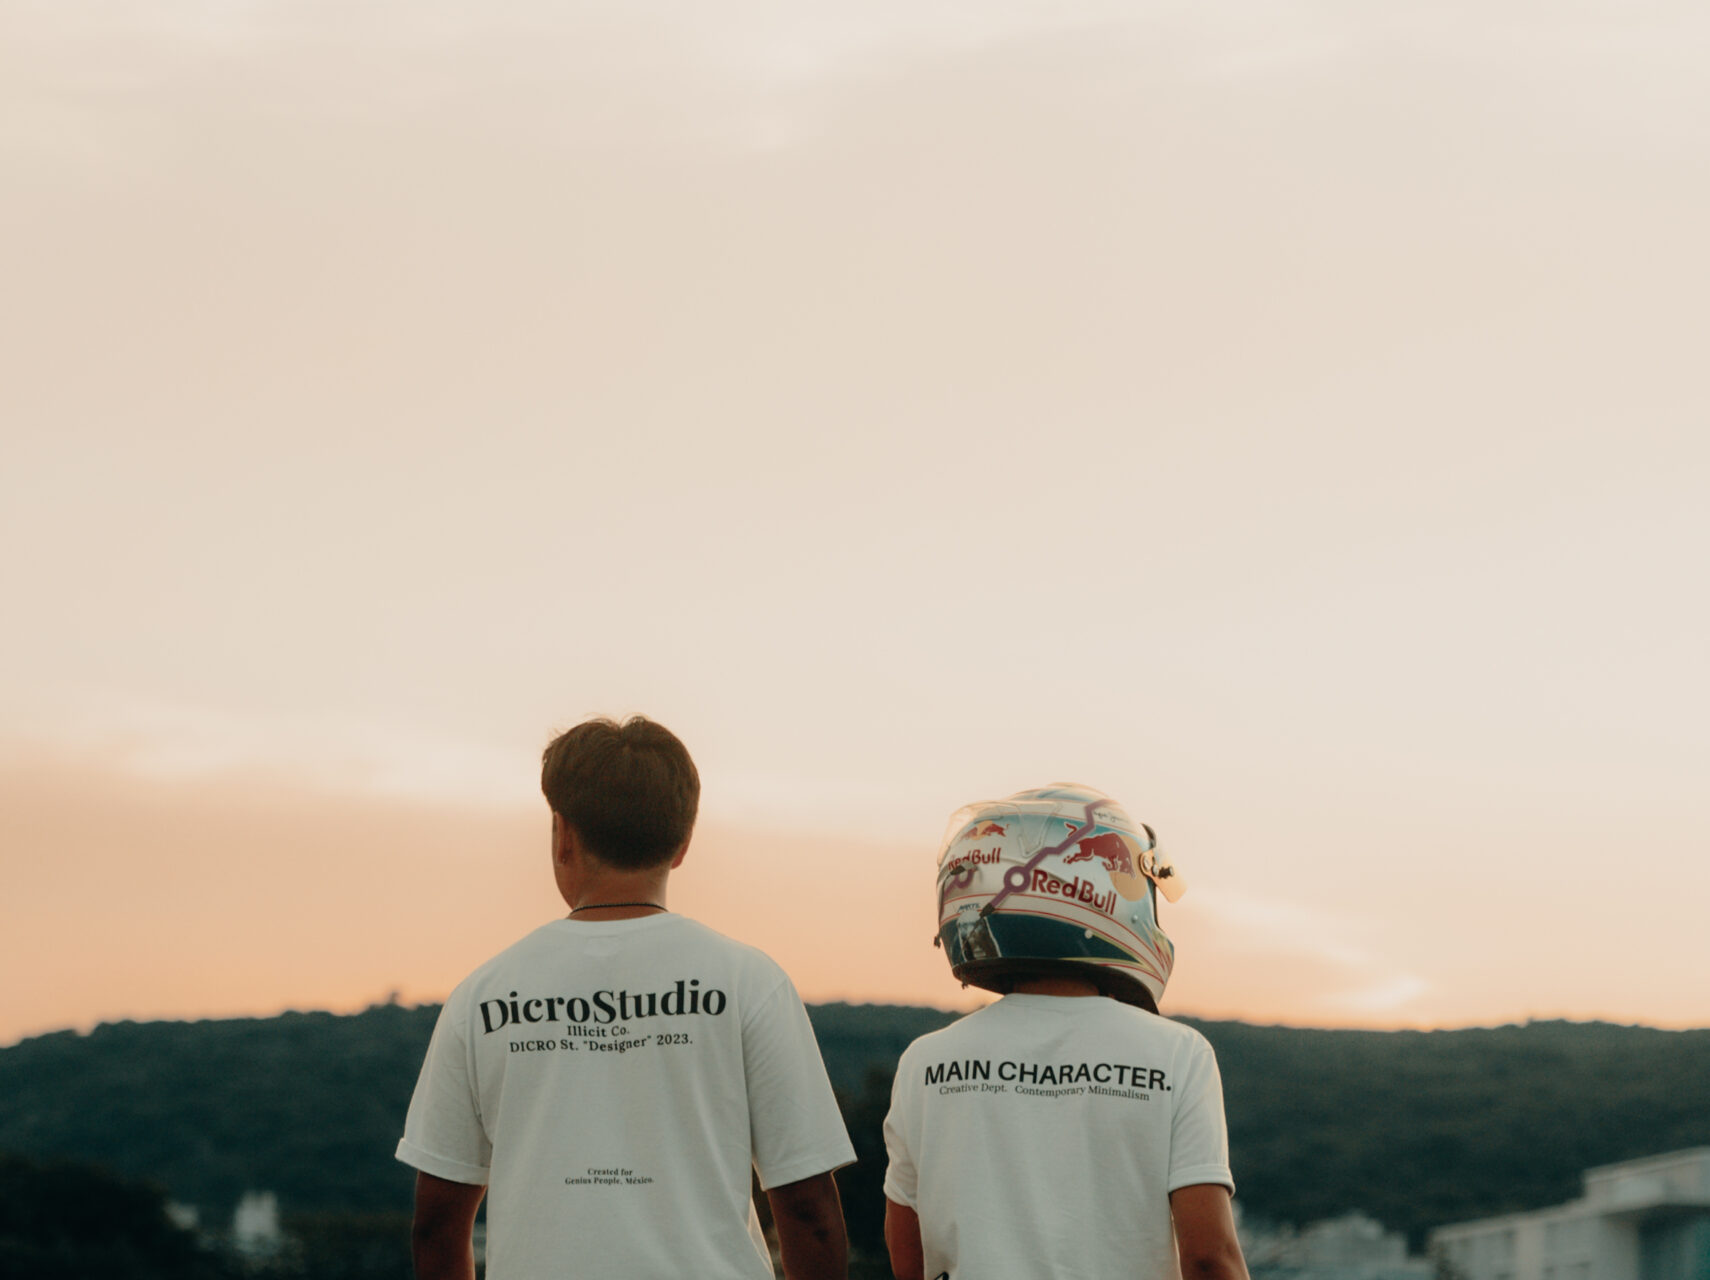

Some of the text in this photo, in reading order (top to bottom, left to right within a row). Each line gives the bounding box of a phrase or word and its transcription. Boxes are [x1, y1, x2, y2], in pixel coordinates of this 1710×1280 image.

[480, 979, 727, 1035] DicroStudio
[567, 1025, 630, 1037] Illicit Co.
[509, 1033, 693, 1053] DICRO St. "Designer" 2023.
[925, 1060, 1172, 1092] MAIN CHARACTER.
[939, 1082, 1150, 1101] Creative Dept. Contemporary Minimalism
[565, 1177, 592, 1185] Genius
[594, 1177, 623, 1186] People,
[587, 1168, 633, 1176] Created for
